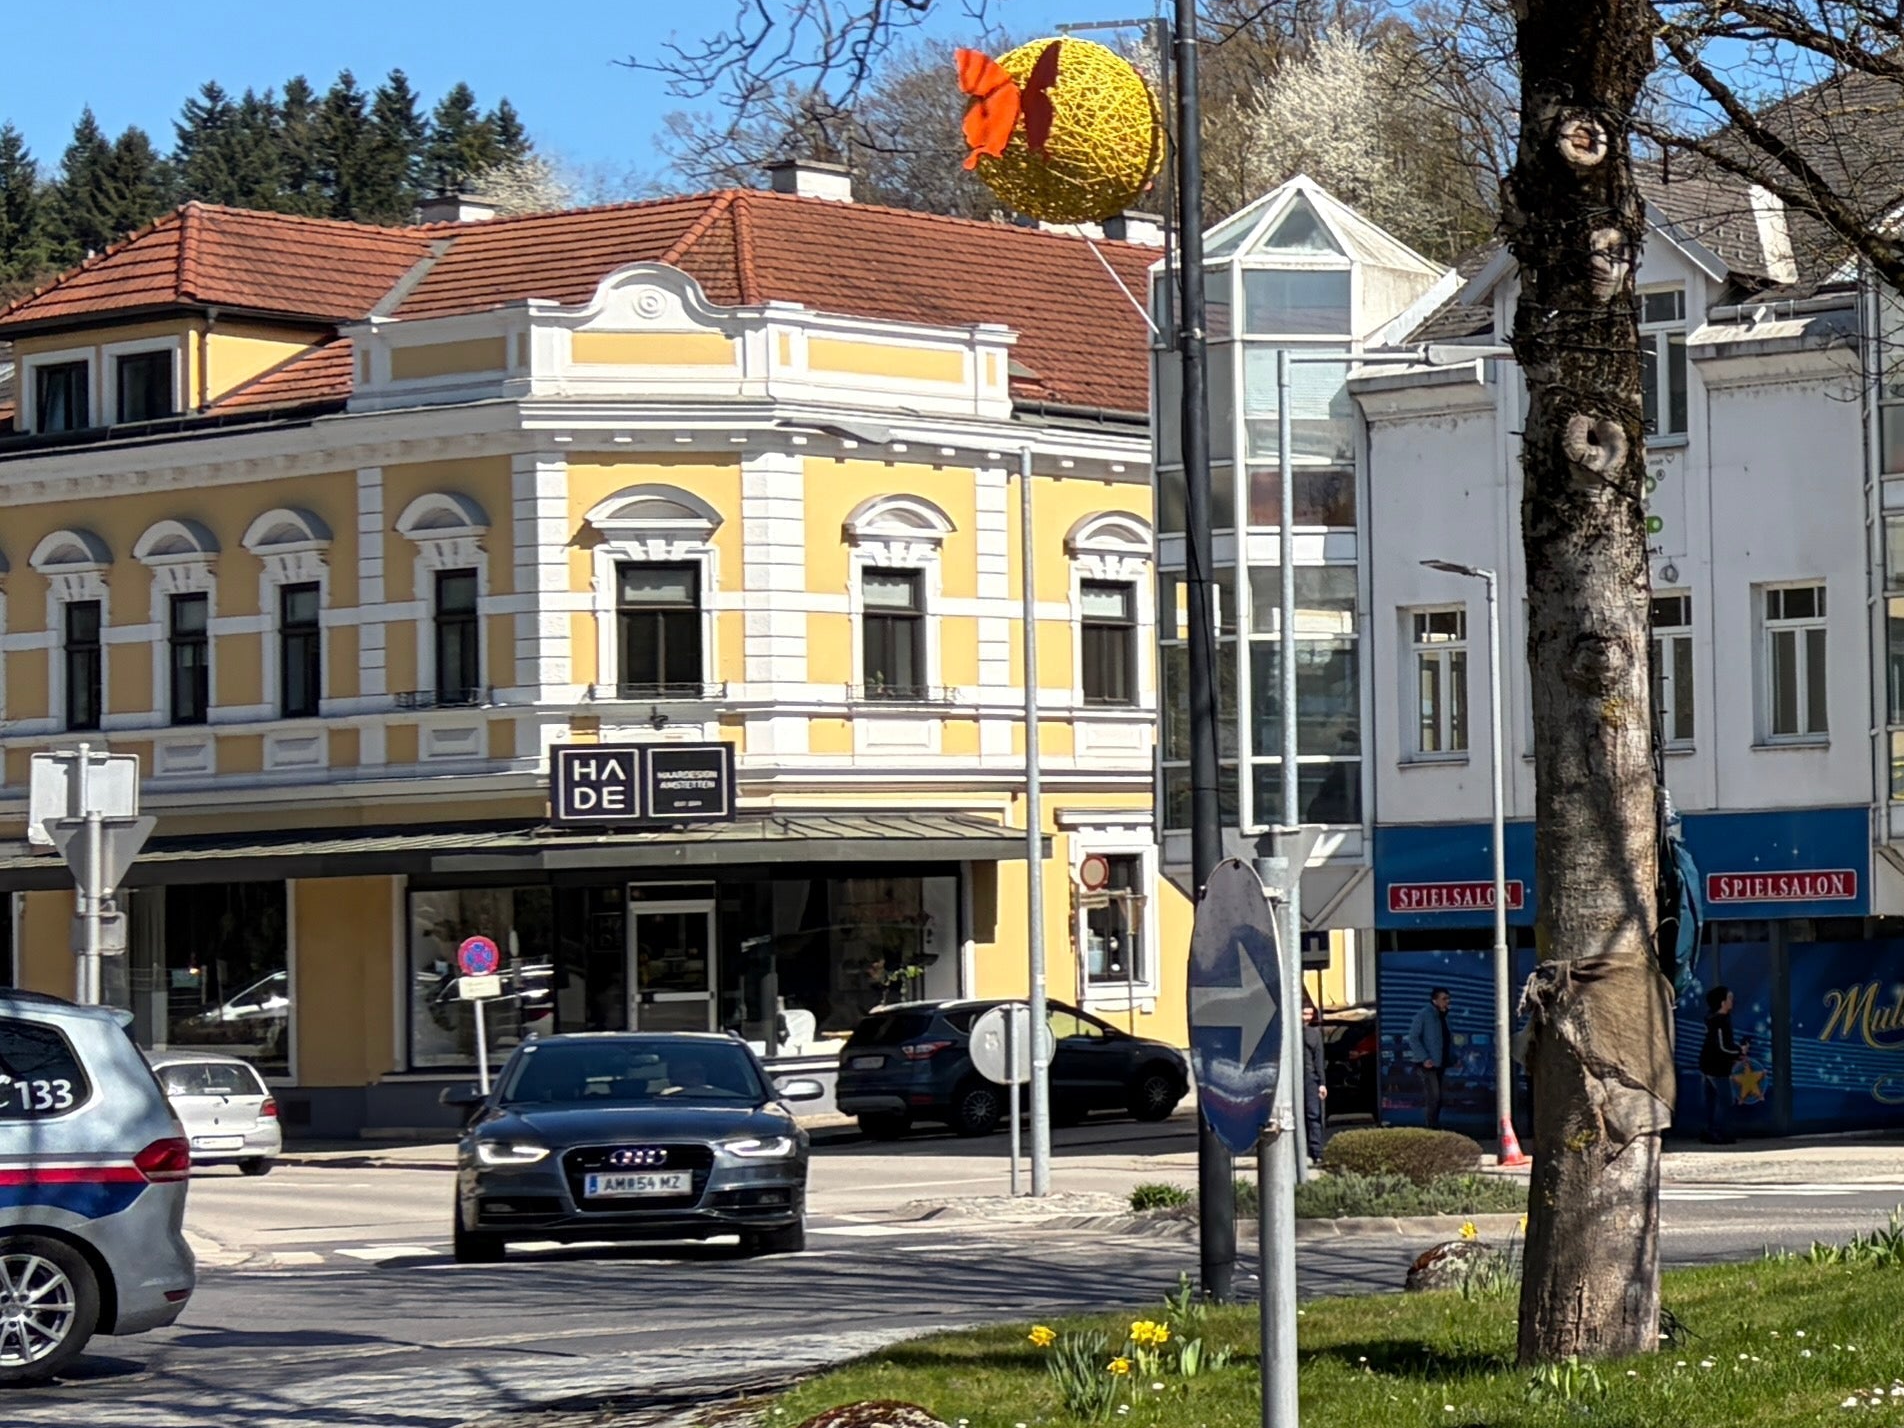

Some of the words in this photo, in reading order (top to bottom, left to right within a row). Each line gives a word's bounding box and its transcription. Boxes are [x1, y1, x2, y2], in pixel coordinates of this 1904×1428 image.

[573, 786, 626, 810] DE
[1399, 884, 1512, 909] SPIELSALON
[1720, 874, 1845, 899] SPIELSALON
[14, 1078, 74, 1110] 133
